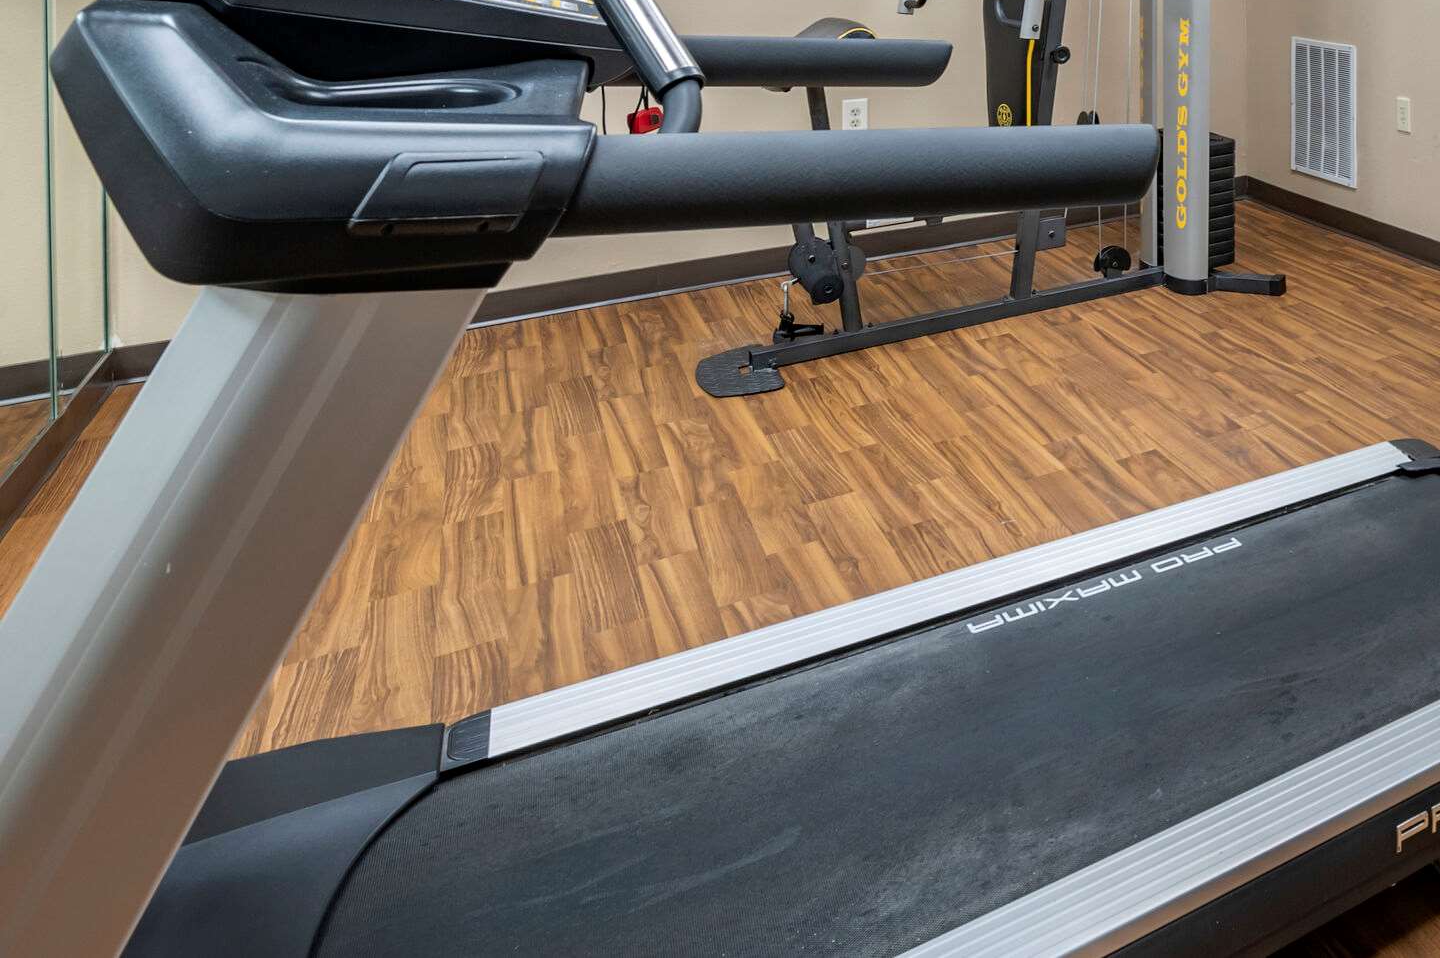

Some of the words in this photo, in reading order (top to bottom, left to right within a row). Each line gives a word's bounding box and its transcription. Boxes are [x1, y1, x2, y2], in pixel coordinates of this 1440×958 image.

[1177, 17, 1191, 97] GYM
[1175, 105, 1188, 230] GOLD'S
[1150, 537, 1243, 574] PRO
[966, 569, 1143, 634] MAXIMA
